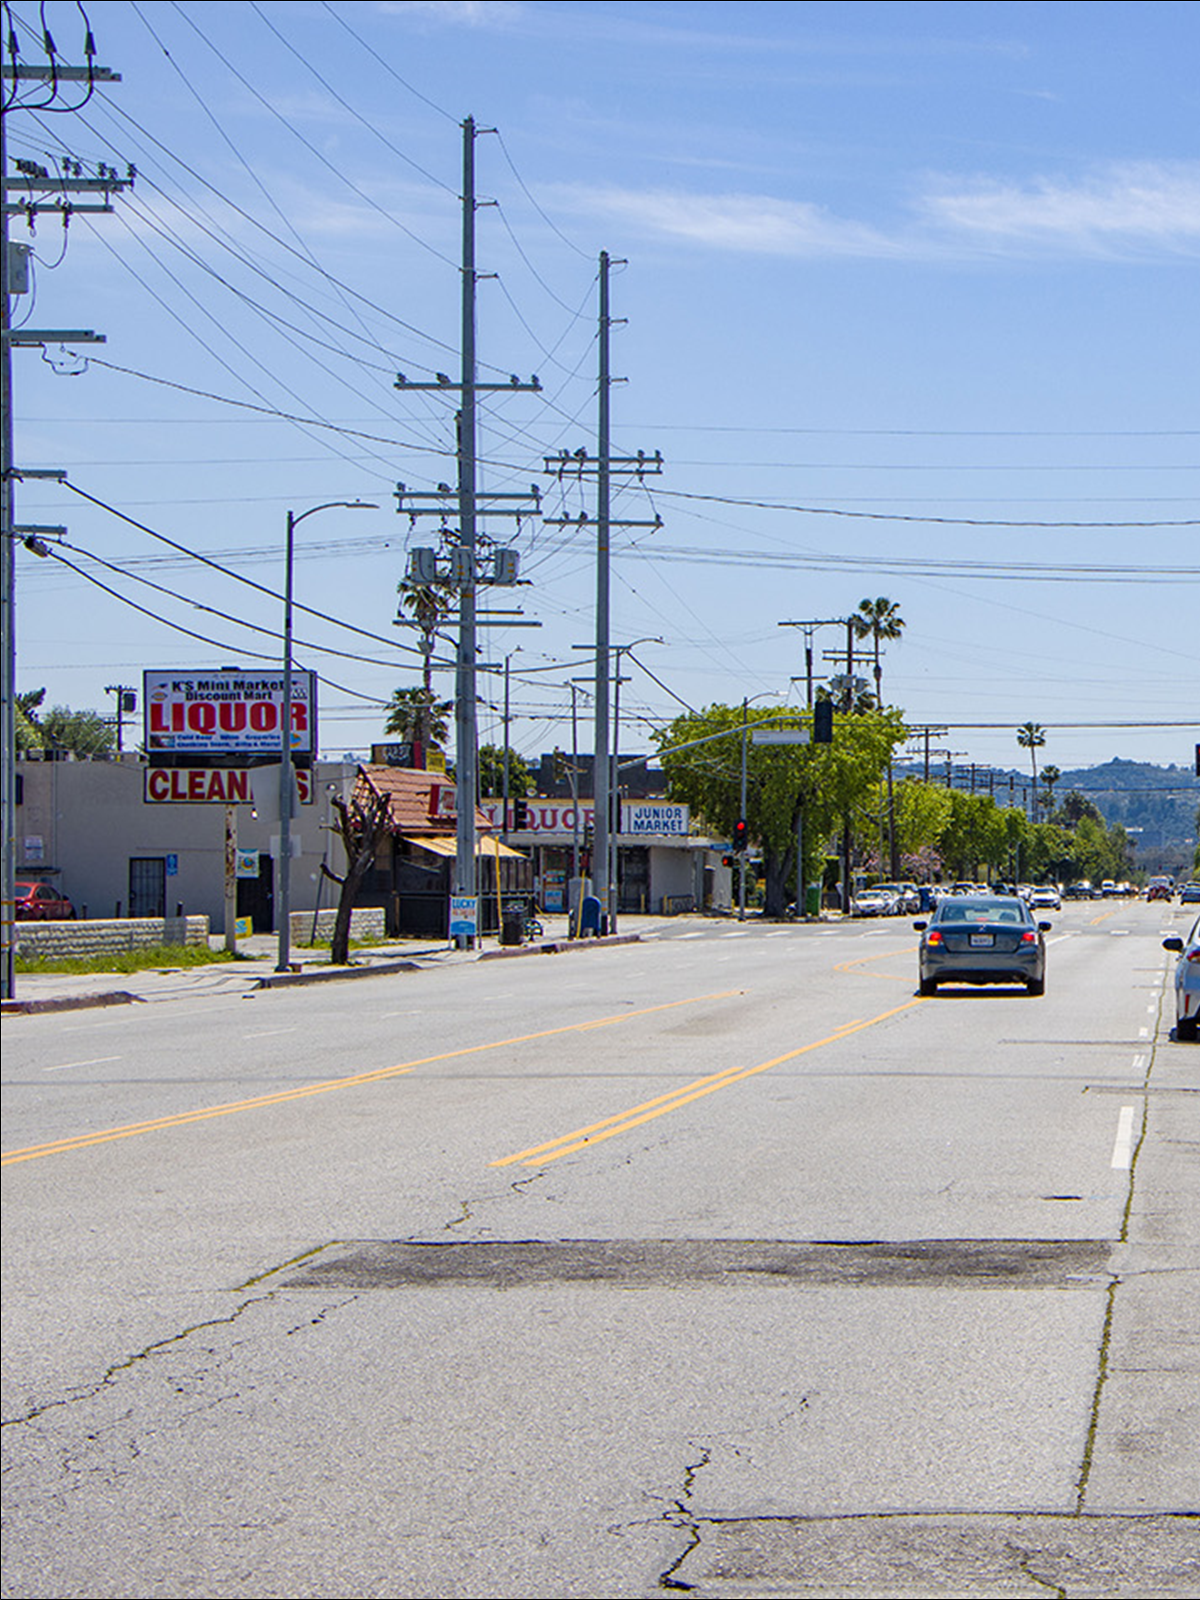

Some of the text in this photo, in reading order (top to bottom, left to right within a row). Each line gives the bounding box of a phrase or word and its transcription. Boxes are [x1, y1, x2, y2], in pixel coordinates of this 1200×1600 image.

[197, 680, 231, 692] Mini
[233, 679, 285, 692] Market
[185, 690, 273, 701] Discount Mart
[150, 701, 308, 735] LIQUOR
[149, 769, 309, 802] CLEANS
[634, 806, 683, 819] JUNIOR
[633, 819, 683, 831] MARKET
